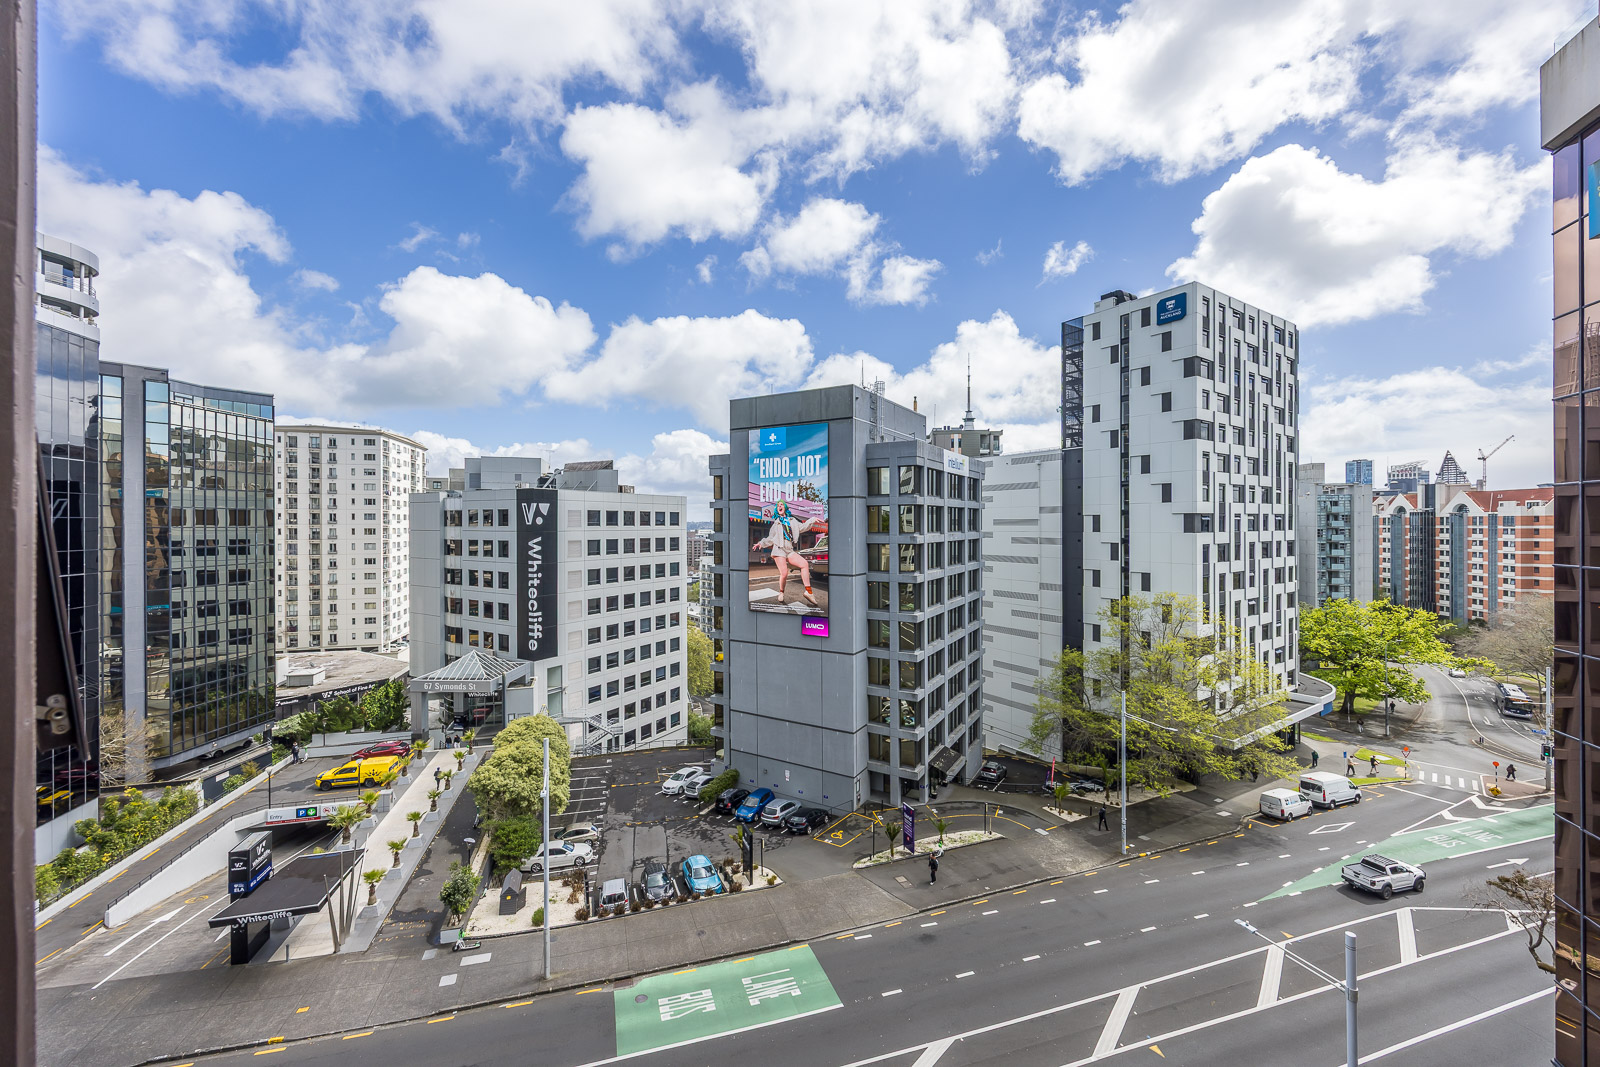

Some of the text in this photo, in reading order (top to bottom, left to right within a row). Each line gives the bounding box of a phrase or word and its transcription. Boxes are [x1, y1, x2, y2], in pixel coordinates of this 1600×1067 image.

[1160, 311, 1182, 319] AUCKLAND
[797, 455, 822, 477] NOT
[760, 481, 781, 502] END
[528, 536, 542, 651] Whitecliffe
[434, 683, 466, 691] Symonds
[1424, 834, 1467, 848] BUS
[1451, 826, 1503, 842] LANE
[237, 911, 293, 925] Whitecliffe
[741, 968, 802, 1006] LANE
[658, 988, 716, 1021] BUS
